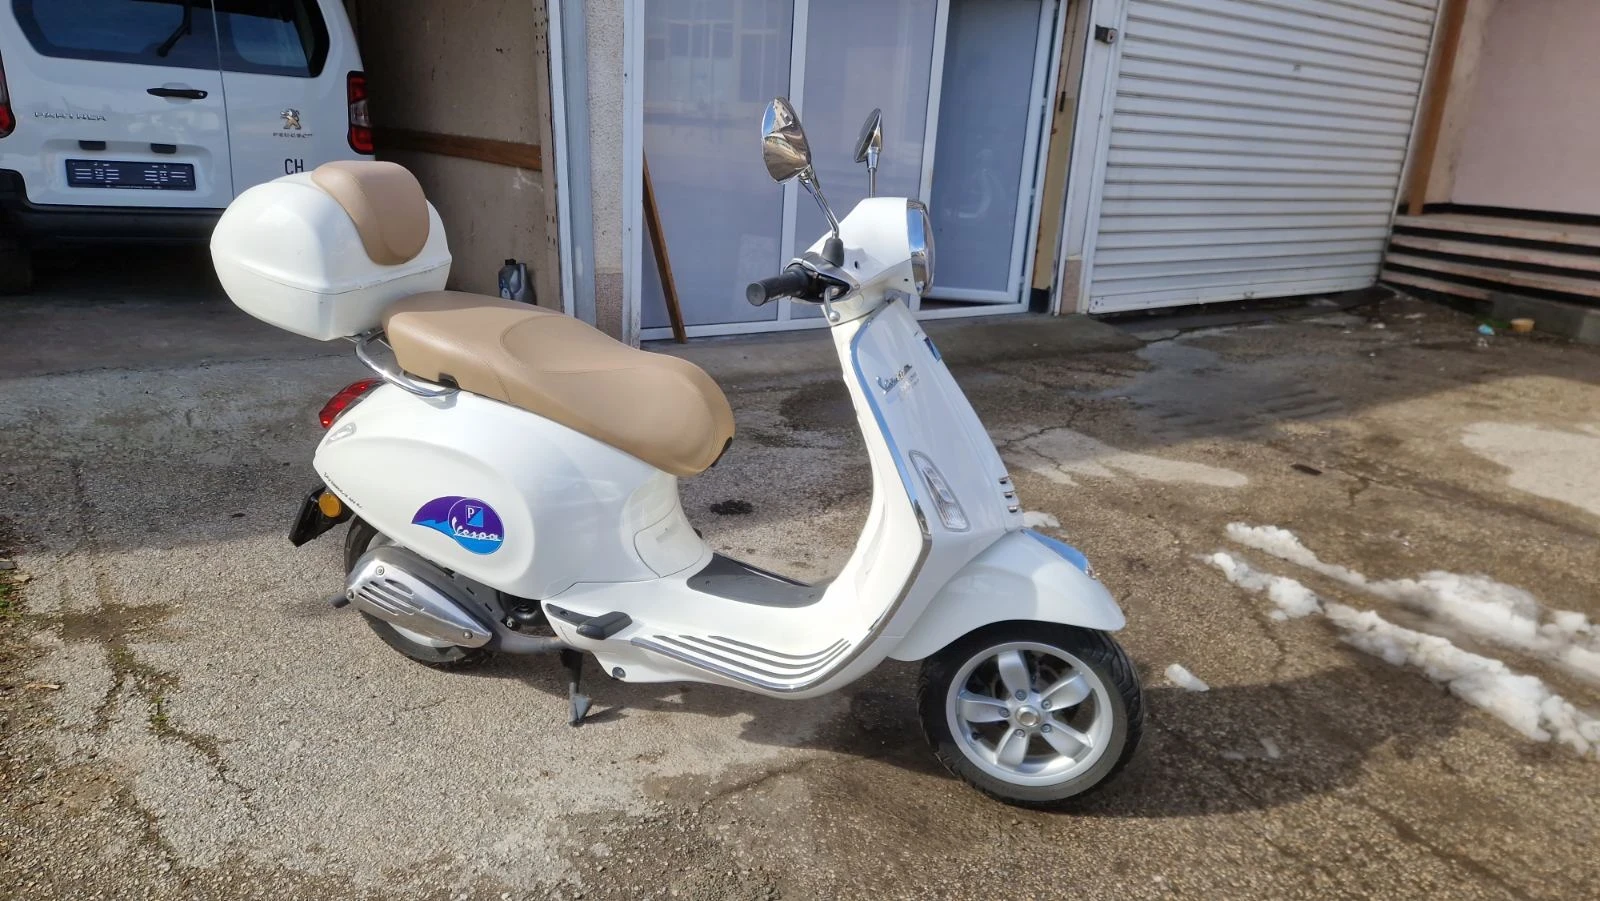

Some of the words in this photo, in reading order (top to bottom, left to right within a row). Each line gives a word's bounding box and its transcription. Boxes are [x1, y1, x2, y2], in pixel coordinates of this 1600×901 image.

[284, 158, 304, 174] CH
[467, 507, 475, 519] P
[451, 516, 502, 541] Vespa
